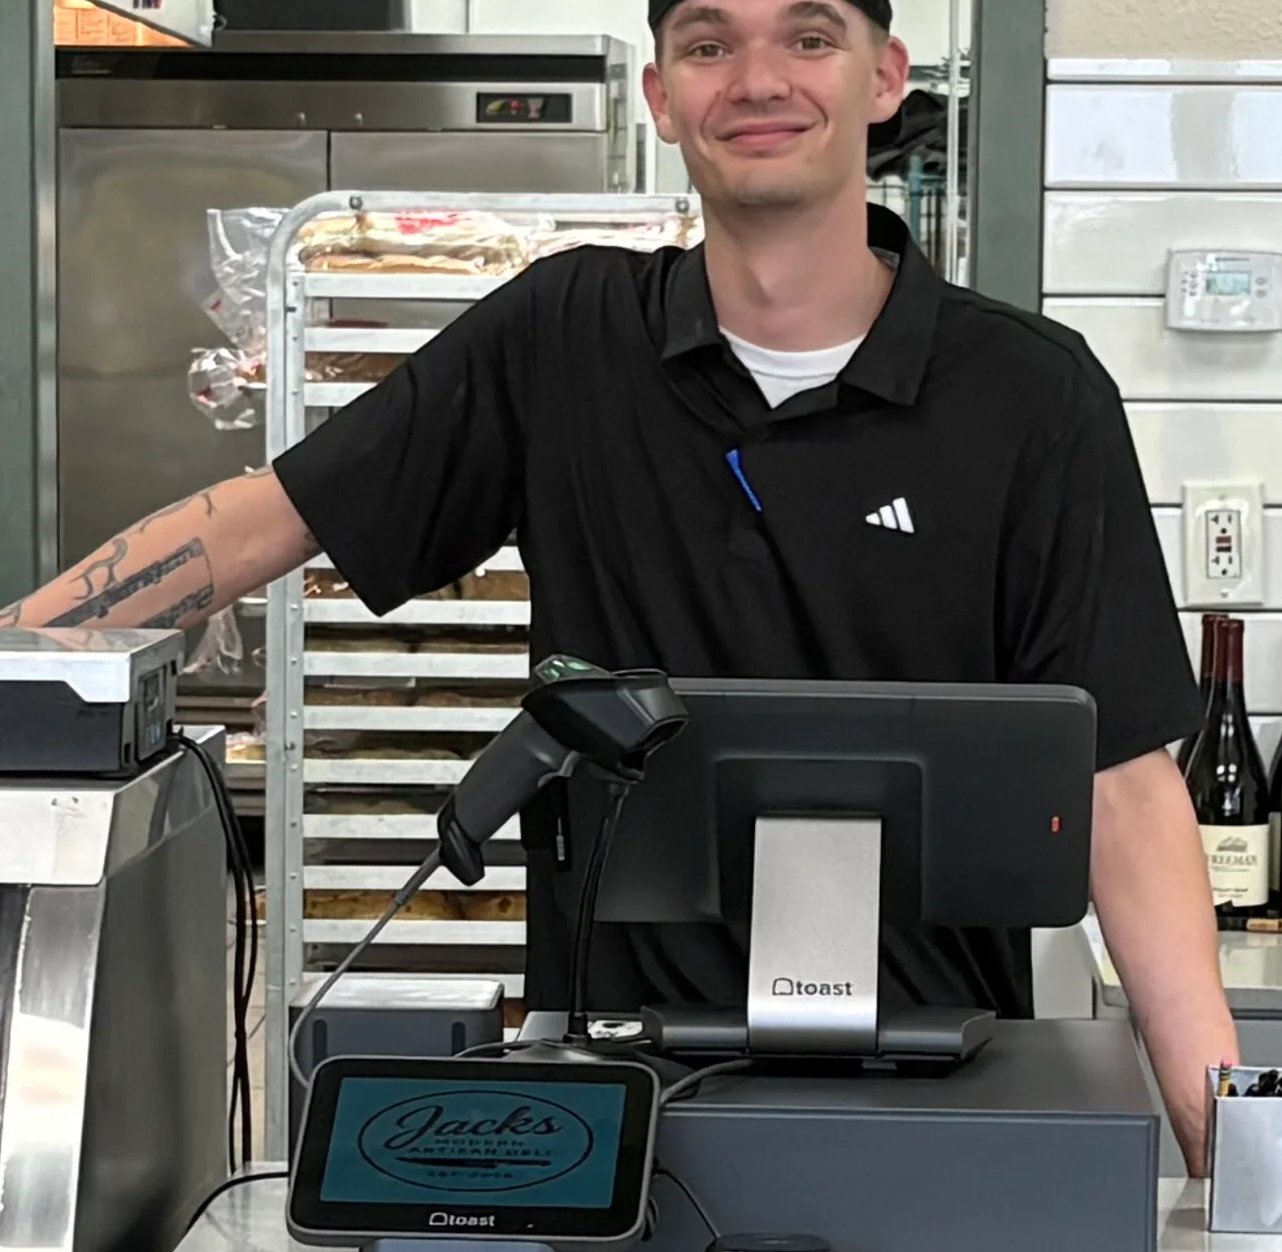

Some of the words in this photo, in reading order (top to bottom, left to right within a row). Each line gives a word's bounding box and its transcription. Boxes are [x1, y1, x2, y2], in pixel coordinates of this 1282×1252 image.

[796, 980, 853, 996] toast
[384, 1105, 564, 1150] Jacks
[449, 1214, 495, 1227] toast
